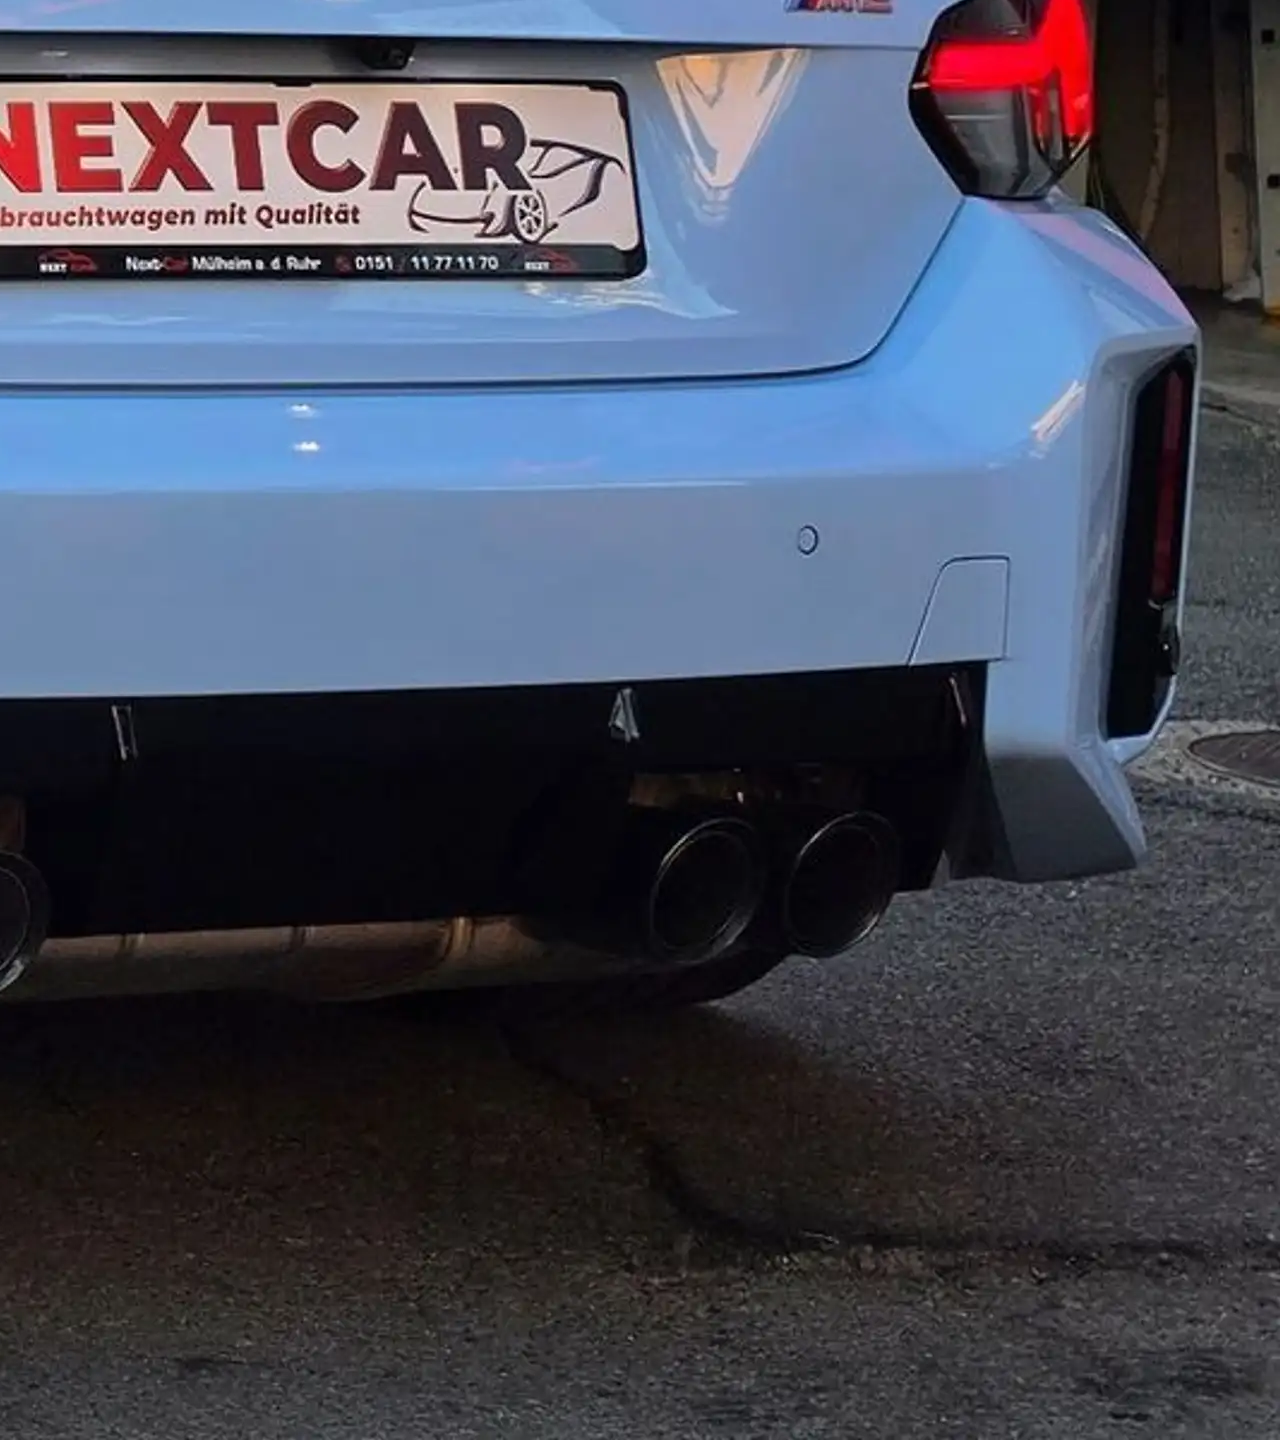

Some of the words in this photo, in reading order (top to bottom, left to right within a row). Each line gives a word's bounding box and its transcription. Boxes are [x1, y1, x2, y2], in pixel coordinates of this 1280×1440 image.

[205, 203, 247, 225] mit
[255, 202, 360, 228] Qualität
[192, 256, 252, 270] Mülheim
[286, 255, 321, 270] Ruhr
[355, 255, 393, 270] 0151
[411, 256, 429, 270] 11
[434, 255, 452, 270] 77
[457, 255, 474, 270] 11
[479, 255, 499, 270] 70
